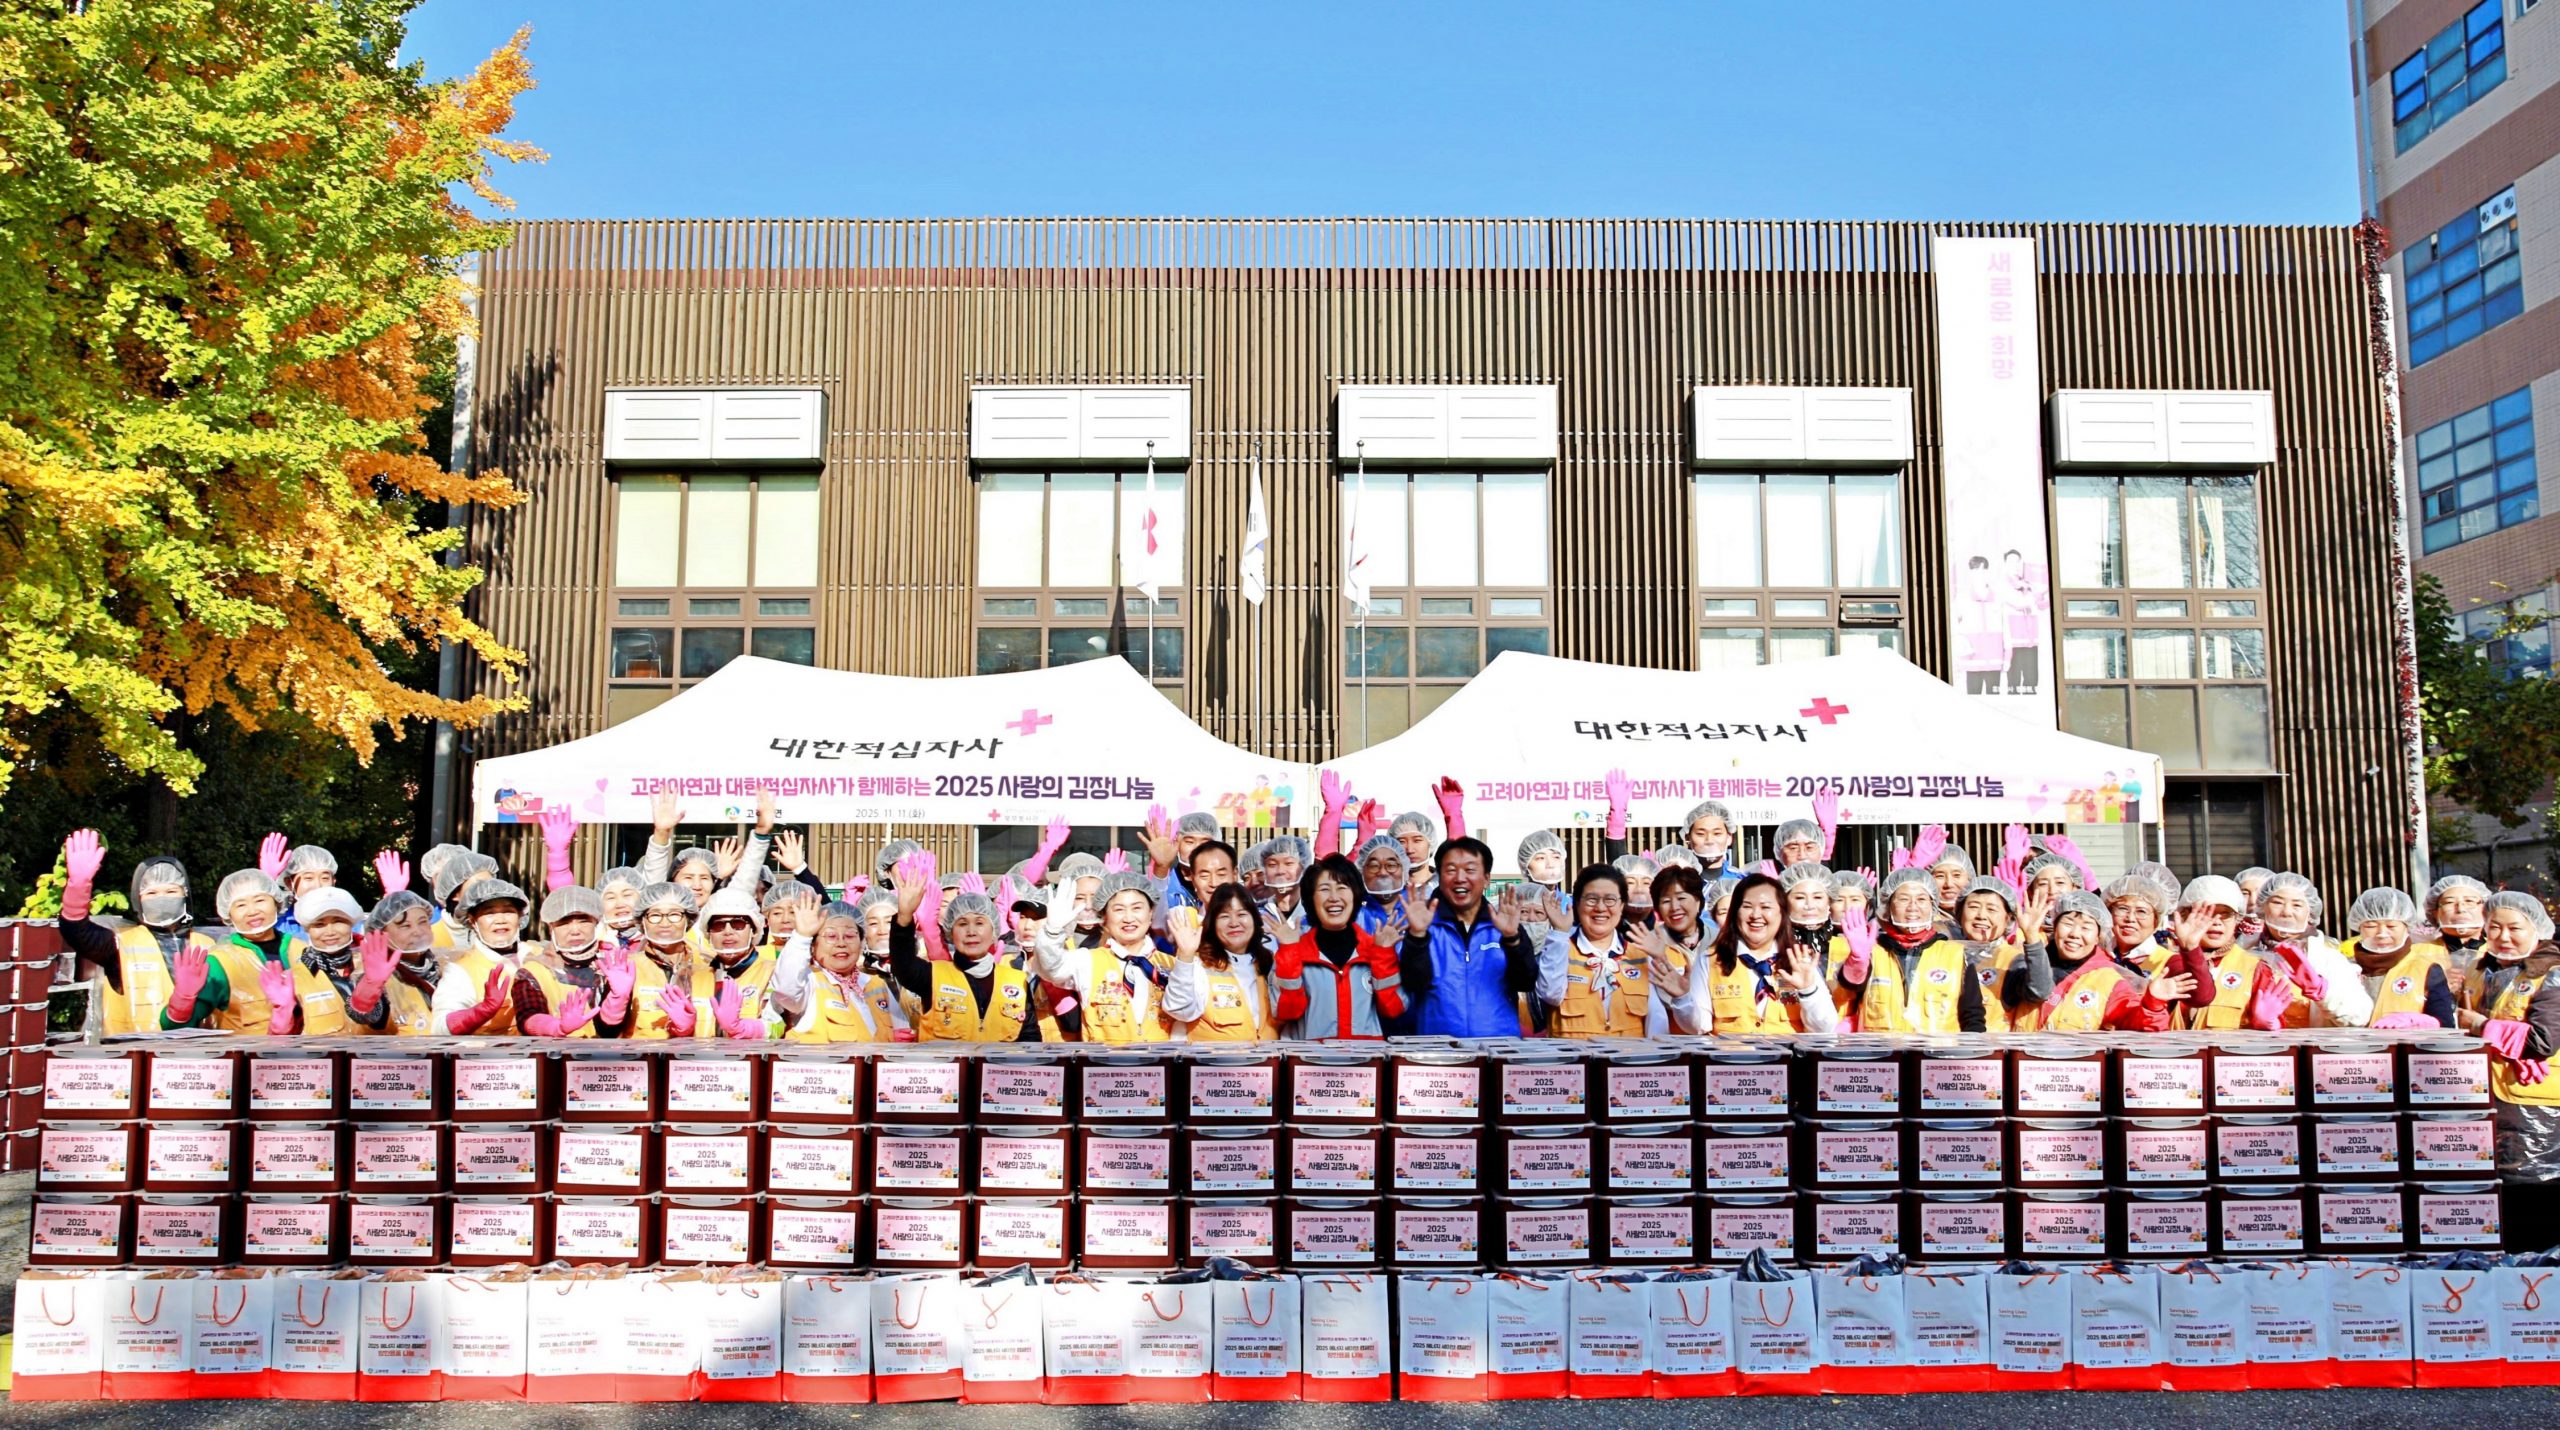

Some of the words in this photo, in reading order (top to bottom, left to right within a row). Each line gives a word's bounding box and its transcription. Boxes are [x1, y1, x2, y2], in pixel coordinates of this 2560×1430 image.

[1987, 252, 2013, 322] 새로운
[1990, 335, 2015, 380] 희망
[1574, 721, 1807, 742] 대한적십자사
[770, 737, 1004, 760] 대한적십자사
[725, 777, 855, 796] 대한적십자사가
[858, 776, 932, 797] 함께하는
[935, 774, 994, 797] 2025
[998, 775, 1062, 799] 사랑의
[1067, 776, 1155, 800] 김장나눔
[1476, 781, 1569, 801] 고려아연과
[1574, 780, 1705, 800] 대한십자사가
[1707, 779, 1782, 799] 함께하는
[1786, 776, 1845, 797] 2025
[1849, 776, 1914, 798] 사랑의
[1918, 776, 2004, 798] 김장나눔
[746, 808, 783, 818] 고연
[2344, 1067, 2363, 1075] 2025
[486, 1073, 505, 1081] 2025
[700, 1074, 719, 1082] 2025
[2154, 1072, 2173, 1080] 2025
[2328, 1077, 2349, 1085] 사랑의
[2351, 1076, 2378, 1085] 김장나눔
[62, 1082, 84, 1090] 사랑의
[85, 1082, 114, 1090] 김장나눔
[265, 1082, 286, 1090] 사랑의
[288, 1081, 316, 1090] 김장나눔
[470, 1082, 491, 1091] 사랑의
[493, 1082, 520, 1090] 김장나눔
[1114, 1080, 1134, 1088] 2025
[1325, 1080, 1345, 1088] 2025
[1534, 1078, 1554, 1086] 2025
[1936, 1082, 1957, 1090] 사랑의
[1959, 1082, 1987, 1090] 김장나눔
[2161, 1081, 2187, 1090] 김장나눔
[707, 1083, 735, 1092] 김장나눔
[892, 1086, 913, 1094] 사랑의
[915, 1086, 943, 1094] 김장나눔
[1518, 1087, 1540, 1096] 사랑의
[1542, 1087, 1569, 1095] 김장나눔
[1721, 1088, 1743, 1096] 사랑의
[1745, 1087, 1772, 1096] 김장나눔
[1098, 1090, 1120, 1098] 사랑의
[1122, 1089, 1149, 1098] 김장나눔
[1309, 1089, 1331, 1097] 사랑의
[1333, 1089, 1360, 1098] 김장나눔
[2445, 1134, 2464, 1142] 2025
[179, 1144, 198, 1152] 2025
[386, 1145, 405, 1153] 2025
[590, 1148, 610, 1156] 2025
[1848, 1145, 1868, 1153] 2025
[2052, 1144, 2072, 1152] 2025
[2429, 1144, 2450, 1152] 사랑의
[2452, 1143, 2479, 1152] 김장나눔
[186, 1153, 213, 1162] 김장나눔
[801, 1153, 821, 1161] 2025
[1012, 1152, 1032, 1160] 2025
[1426, 1152, 1446, 1160] 2025
[2036, 1154, 2057, 1162] 사랑의
[2059, 1153, 2087, 1162] 김장나눔
[2234, 1149, 2255, 1158] 사랑의
[2256, 1148, 2283, 1157] 김장나눔
[370, 1154, 391, 1163] 사랑의
[393, 1154, 420, 1162] 김장나눔
[574, 1156, 595, 1165] 사랑의
[597, 1157, 625, 1166] 김장나눔
[1223, 1154, 1242, 1162] 2025
[1832, 1155, 1854, 1163] 사랑의
[1856, 1154, 1883, 1163] 김장나눔
[785, 1162, 807, 1170] 사랑의
[809, 1162, 836, 1171] 김장나눔
[996, 1161, 1018, 1169] 사랑의
[1020, 1161, 1047, 1170] 김장나눔
[1207, 1163, 1228, 1172] 사랑의
[1230, 1162, 1258, 1171] 김장나눔
[1433, 1161, 1461, 1170] 김장나눔
[1625, 1161, 1646, 1169] 사랑의
[1648, 1161, 1676, 1169] 김장나눔
[2351, 1207, 2371, 1215] 2025
[66, 1218, 86, 1226] 2025
[483, 1218, 502, 1226] 2025
[1953, 1217, 1973, 1225] 2025
[2158, 1216, 2177, 1224] 2025
[2335, 1216, 2357, 1225] 사랑의
[2359, 1216, 2386, 1224] 김장나눔
[698, 1224, 717, 1232] 2025
[1538, 1224, 1558, 1232] 2025
[1743, 1222, 1762, 1230] 2025
[1937, 1226, 1959, 1235] 사랑의
[1961, 1226, 1988, 1234] 김장나눔
[2143, 1225, 2164, 1234] 사랑의
[2165, 1225, 2192, 1233] 김장나눔
[50, 1227, 72, 1235] 사랑의
[74, 1227, 102, 1236] 김장나눔
[262, 1227, 283, 1235] 사랑의
[285, 1227, 313, 1235] 김장나눔
[467, 1227, 488, 1235] 사랑의
[490, 1227, 517, 1236] 김장나눔
[1101, 1228, 1123, 1236] 사랑의
[1125, 1228, 1152, 1236] 김장나눔
[1727, 1232, 1748, 1240] 사랑의
[1750, 1231, 1778, 1240] 김장나눔
[682, 1233, 703, 1241] 사랑의
[705, 1233, 733, 1242] 김장나눔
[892, 1232, 914, 1241] 사랑의
[916, 1233, 943, 1241] 김장나눔
[1308, 1234, 1329, 1242] 사랑의
[1331, 1234, 1359, 1242] 김장나눔
[1522, 1234, 1544, 1243] 사랑의
[1546, 1232, 1573, 1242] 김장나눔
